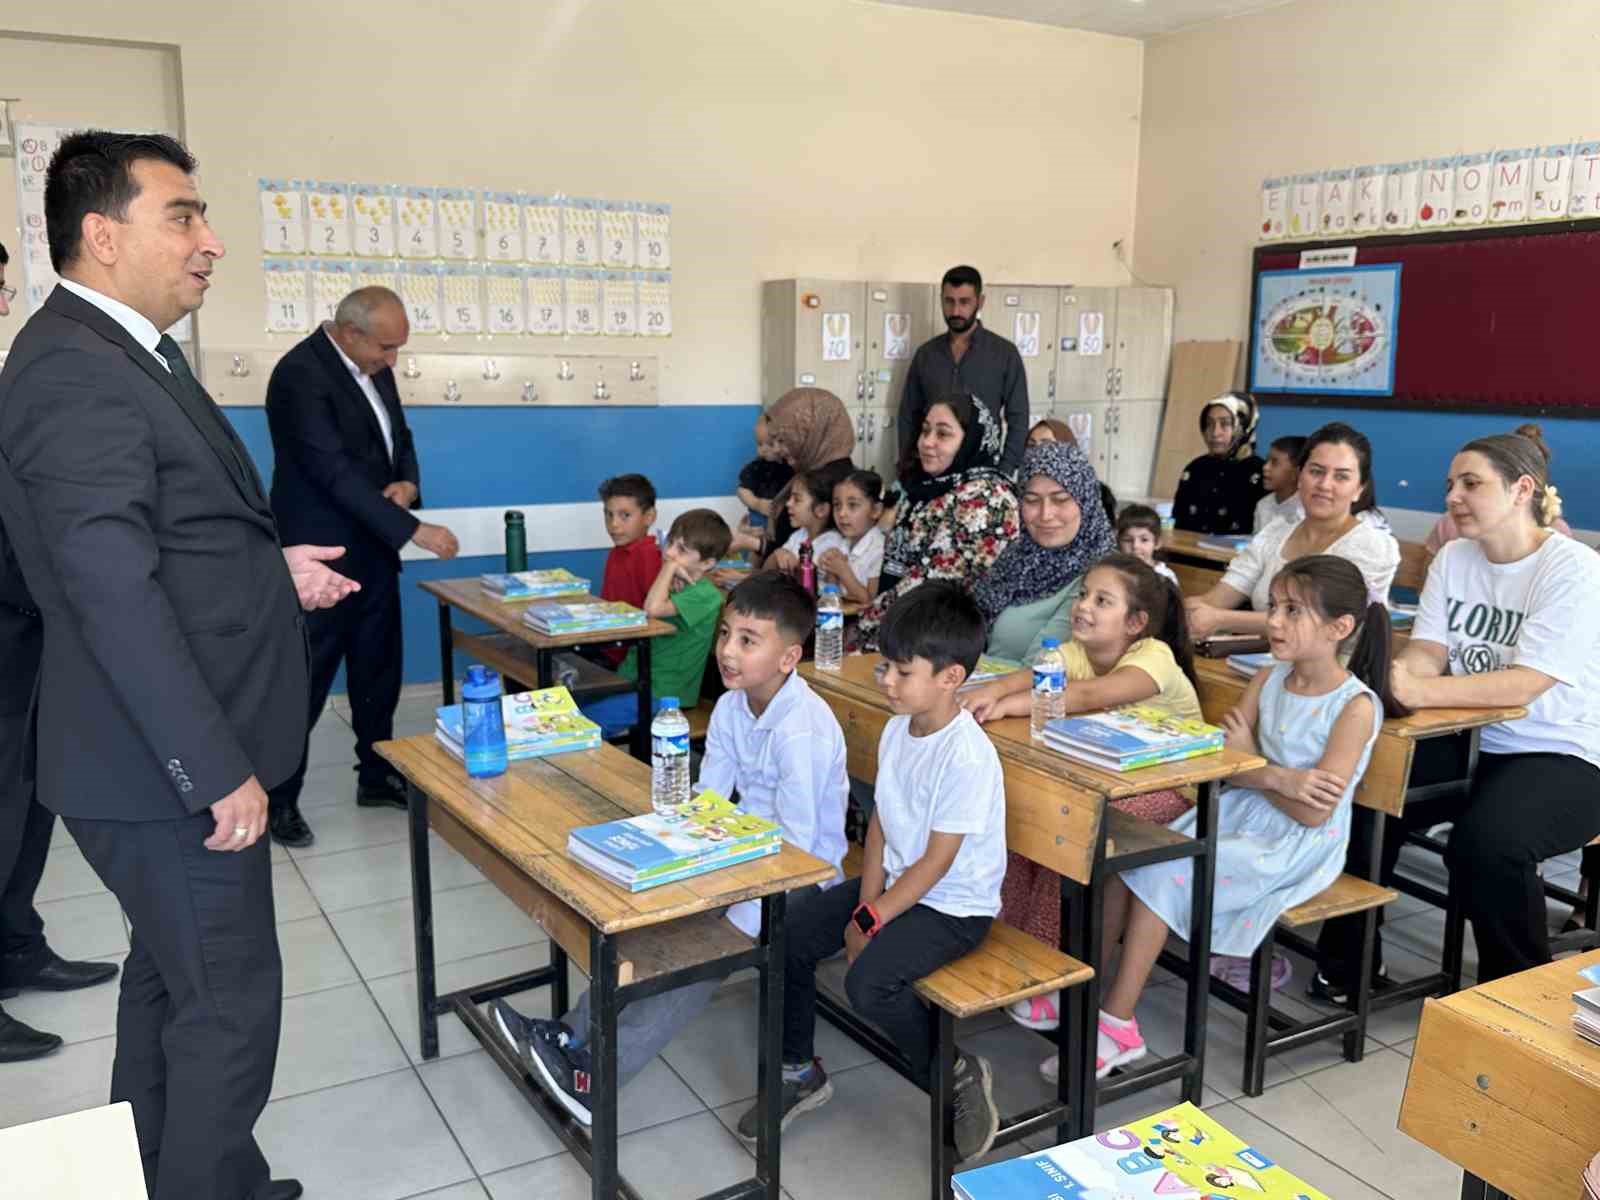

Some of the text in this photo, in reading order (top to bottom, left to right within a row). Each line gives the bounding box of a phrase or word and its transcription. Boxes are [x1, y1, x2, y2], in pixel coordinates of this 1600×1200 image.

[1268, 191, 1279, 211] E
[1300, 184, 1310, 206] L
[1328, 183, 1342, 202] A
[1361, 179, 1373, 201] K
[1429, 172, 1446, 193] N
[1463, 168, 1481, 191] O
[1500, 164, 1521, 188] M
[1543, 160, 1561, 183] U
[1584, 157, 1600, 181] T
[1438, 207, 1449, 220] n
[1508, 200, 1522, 212] m
[280, 225, 662, 257] 1 2 3 4 5 6 7 8 9 10
[281, 303, 296, 319] 11
[413, 306, 430, 321] 14
[456, 307, 471, 323] 15
[499, 308, 514, 323] 16
[540, 308, 553, 323] 17
[576, 309, 590, 323] 18
[613, 310, 627, 325] 19
[647, 311, 664, 326] 20
[829, 338, 846, 358] 10
[1084, 335, 1100, 353] 50
[1034, 1160, 1067, 1183] SINIF
